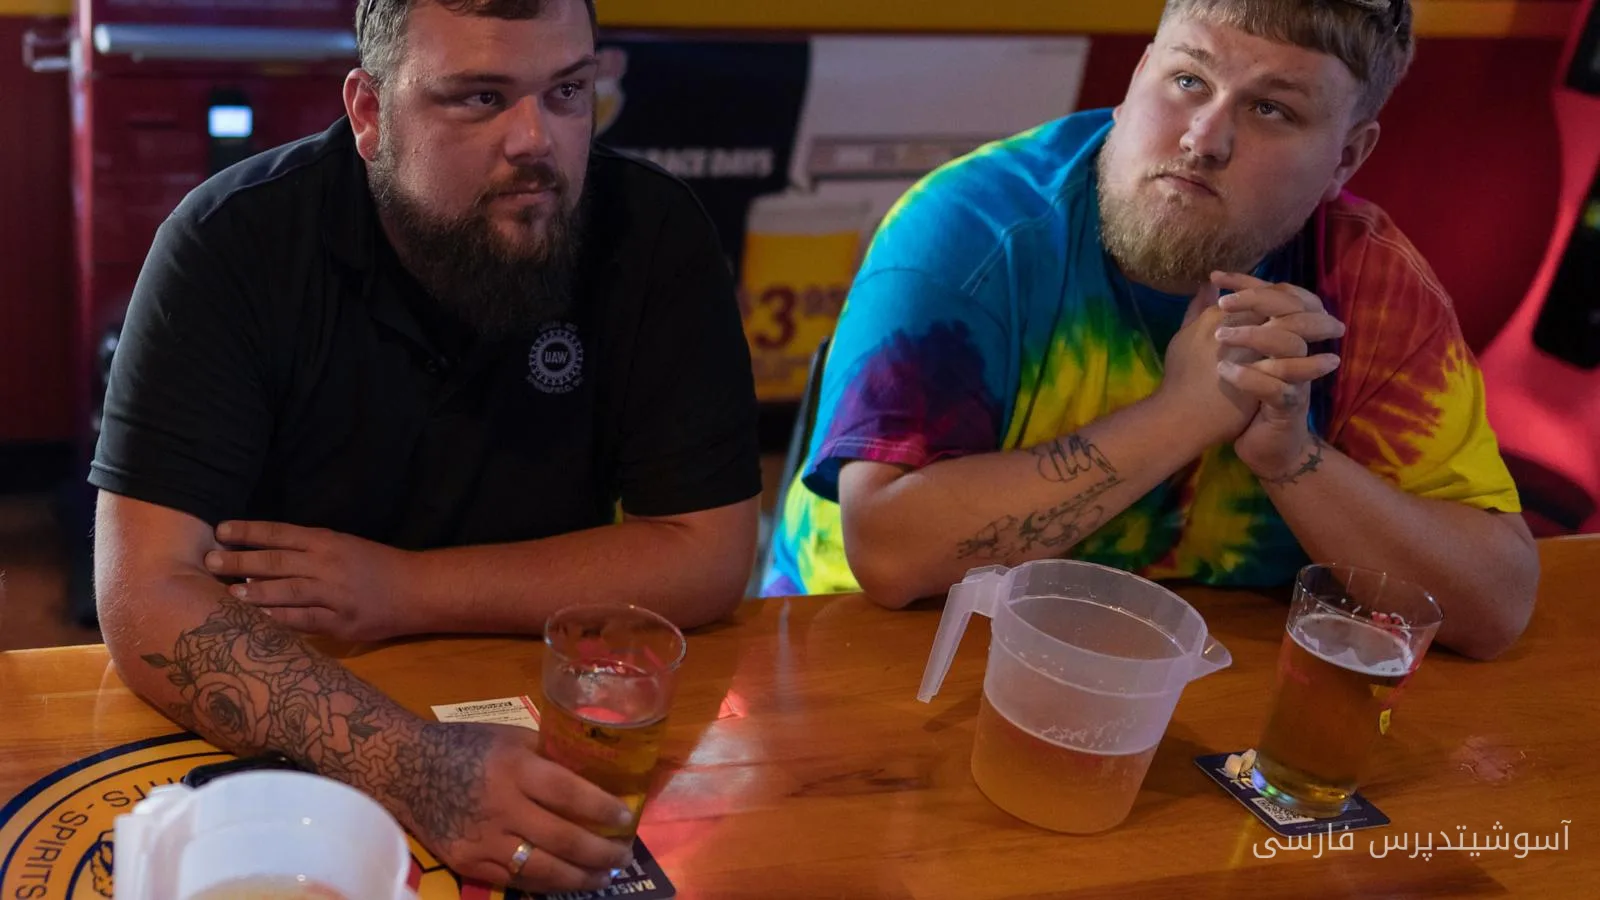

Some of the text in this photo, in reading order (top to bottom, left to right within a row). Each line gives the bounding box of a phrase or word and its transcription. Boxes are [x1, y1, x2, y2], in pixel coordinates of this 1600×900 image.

[710, 148, 774, 178] DAYS
[544, 351, 569, 364] UAW
[15, 810, 89, 900] SPIRITS
[608, 879, 657, 895] RAISE
